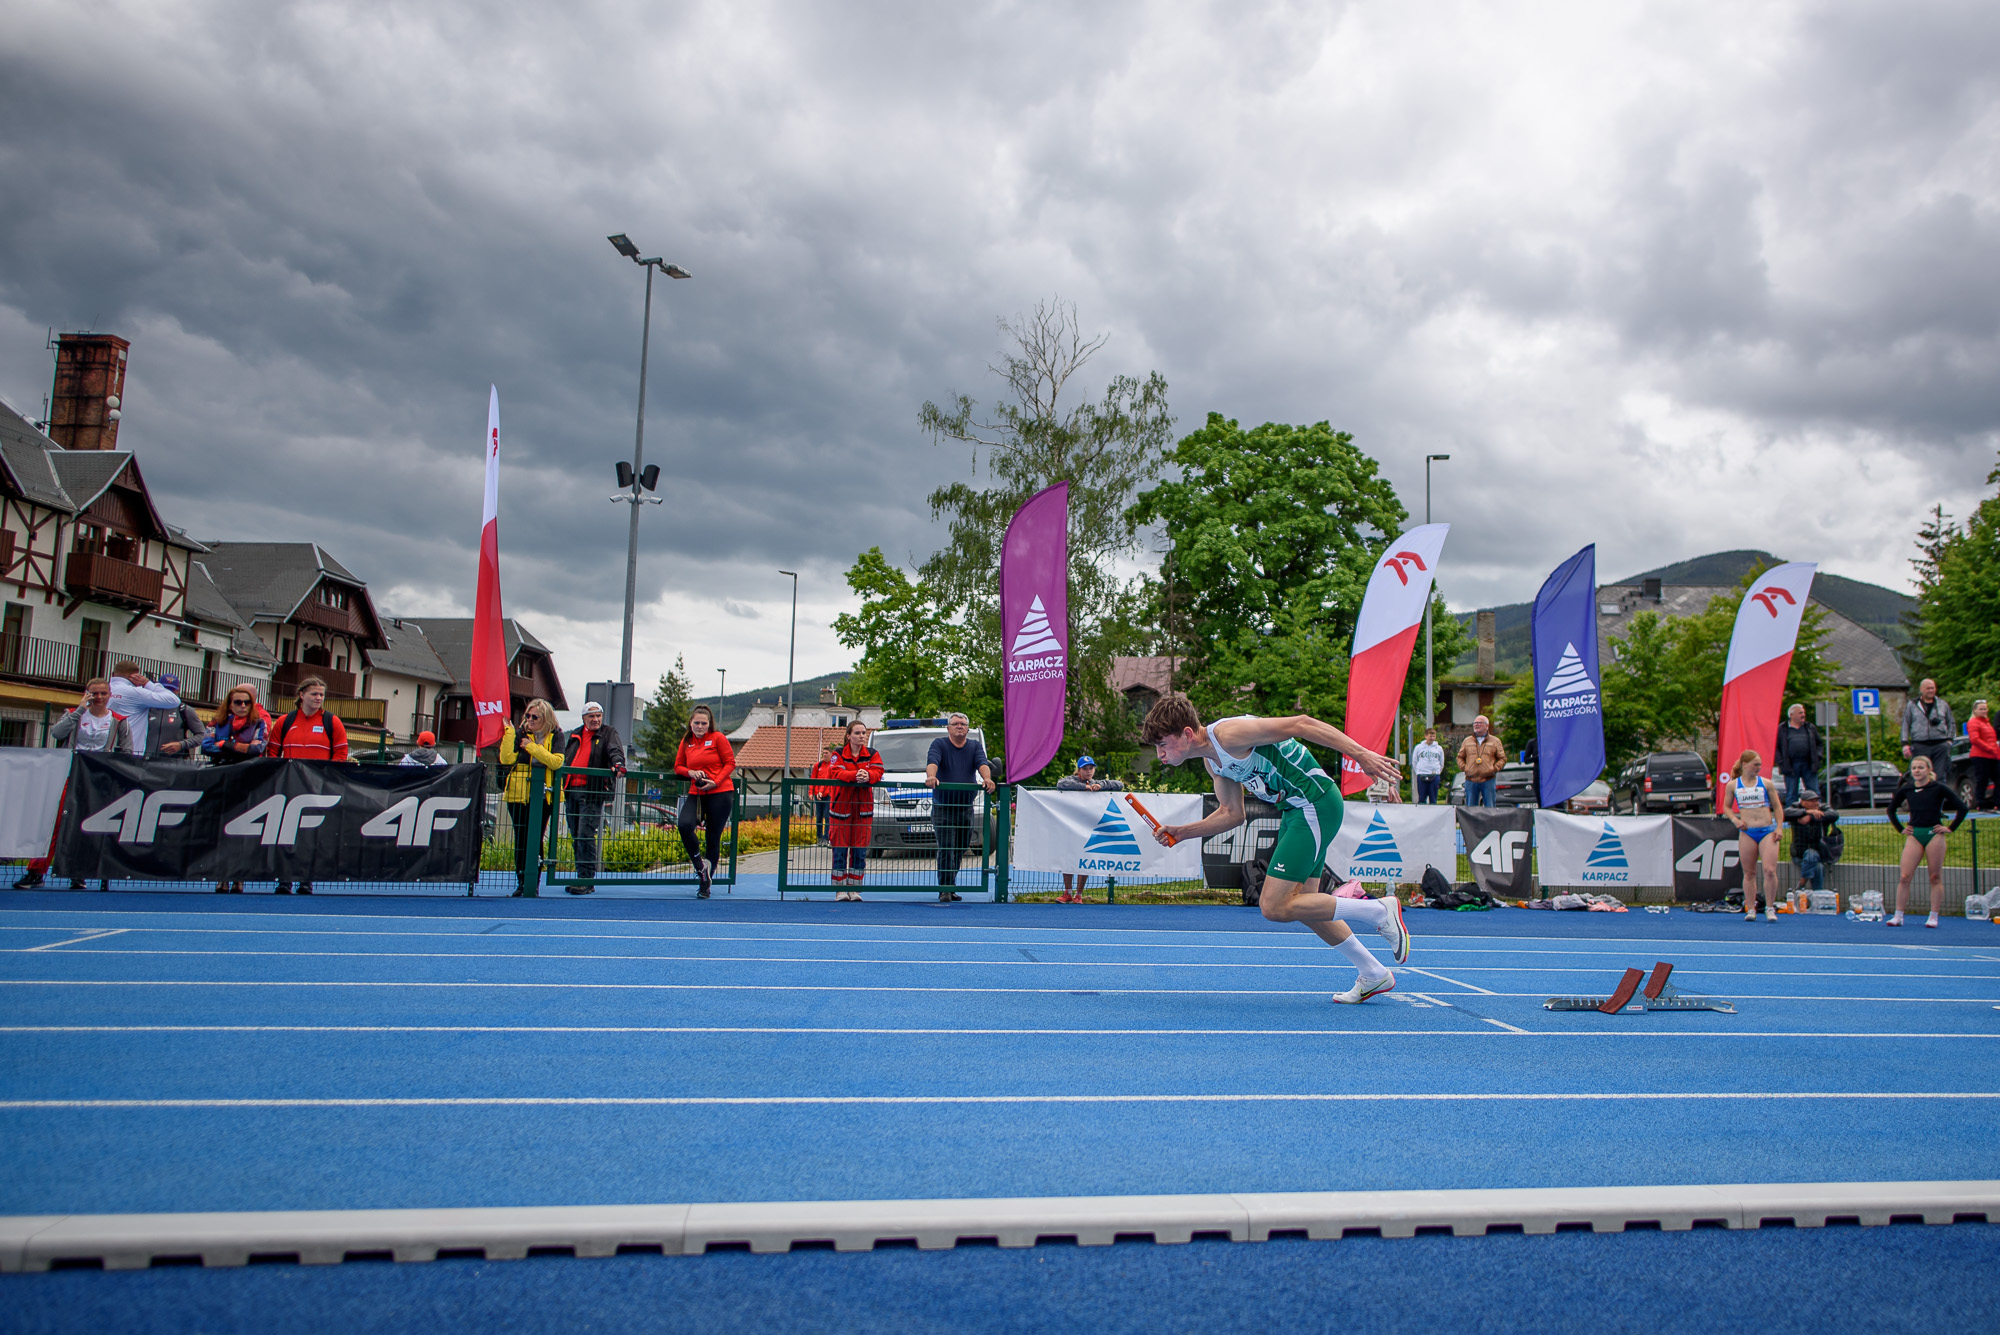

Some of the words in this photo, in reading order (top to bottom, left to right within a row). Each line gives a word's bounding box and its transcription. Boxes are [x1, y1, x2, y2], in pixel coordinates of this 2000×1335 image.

[1009, 656, 1064, 673] KARPACZ
[476, 700, 503, 716] EN
[1543, 694, 1597, 709] KARPACZ
[1859, 692, 1874, 712] P
[1543, 708, 1574, 719] ZAWSZE
[1574, 705, 1598, 715] GÓRĄ
[81, 789, 204, 843] 4F
[224, 794, 342, 845] 4F
[361, 796, 472, 846] 4F
[1203, 818, 1283, 864] 4F
[1471, 830, 1529, 873] 4F
[1675, 839, 1739, 880] 4F
[1078, 858, 1141, 872] KARPACZ
[1349, 866, 1403, 878] KARPACZ
[1582, 871, 1629, 881] KARPACZ
